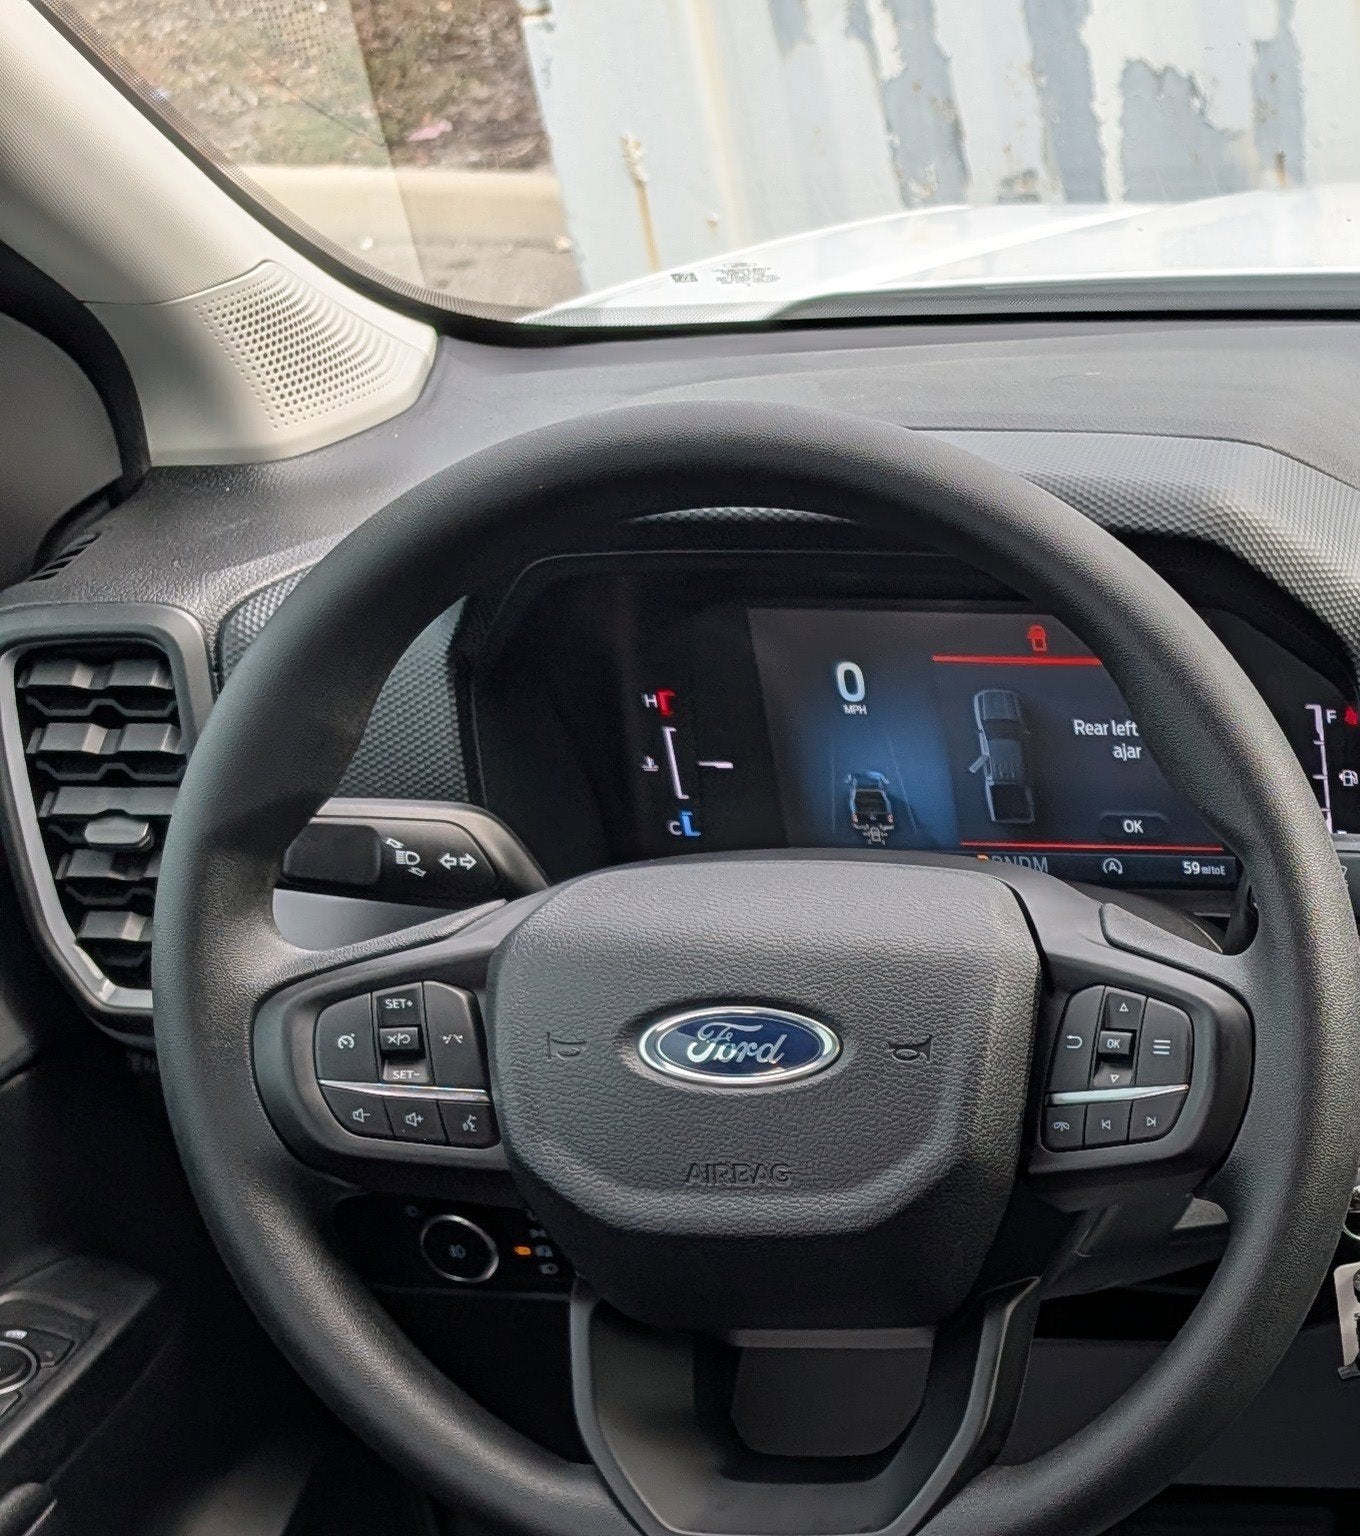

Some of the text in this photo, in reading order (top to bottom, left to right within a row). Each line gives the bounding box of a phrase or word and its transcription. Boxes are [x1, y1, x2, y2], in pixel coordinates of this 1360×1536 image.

[837, 661, 866, 702] 0
[642, 693, 657, 708] H
[843, 704, 868, 715] MPH
[1326, 709, 1337, 724] F
[1073, 718, 1139, 737] Rear left
[1112, 742, 1142, 762] ajar
[667, 820, 682, 836] C
[1123, 820, 1144, 834] OK
[1182, 860, 1201, 875] 59
[385, 998, 413, 1009] SET+
[686, 1021, 788, 1064] Ford
[1106, 1038, 1121, 1049] OK
[685, 1161, 792, 1185] AIRBAG
